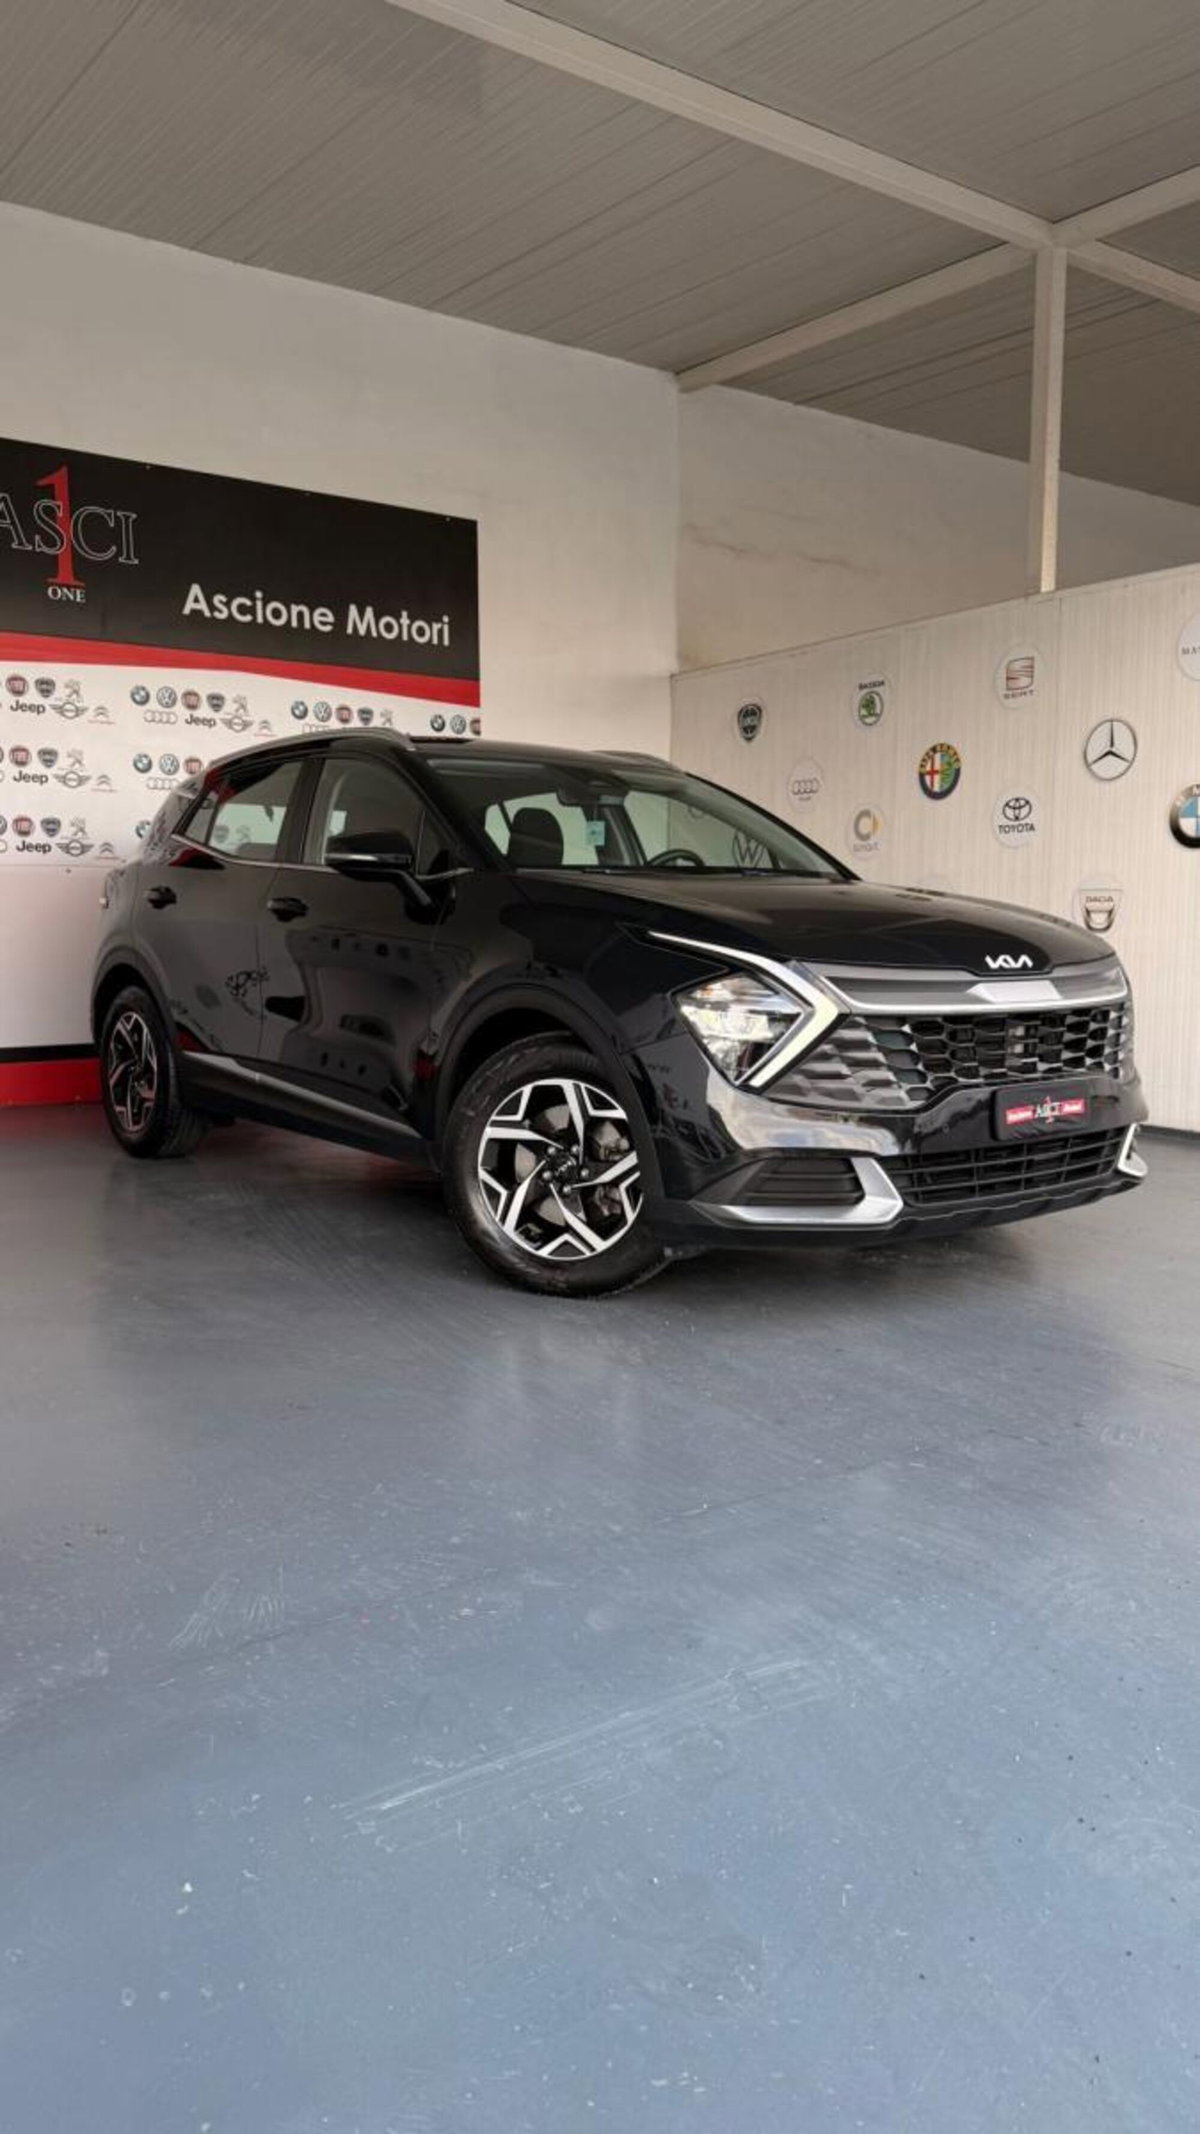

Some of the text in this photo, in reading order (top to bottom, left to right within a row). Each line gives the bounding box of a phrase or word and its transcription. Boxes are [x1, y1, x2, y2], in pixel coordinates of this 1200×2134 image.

[47, 586, 86, 602] ONE
[182, 583, 449, 646] Ascione Motori
[1182, 646, 1200, 655] MA
[10, 700, 46, 715] Jeep
[184, 713, 216, 728] Jeep
[13, 770, 49, 785] Jeep
[998, 823, 1035, 834] TOYOTA
[16, 840, 52, 855] Jeep
